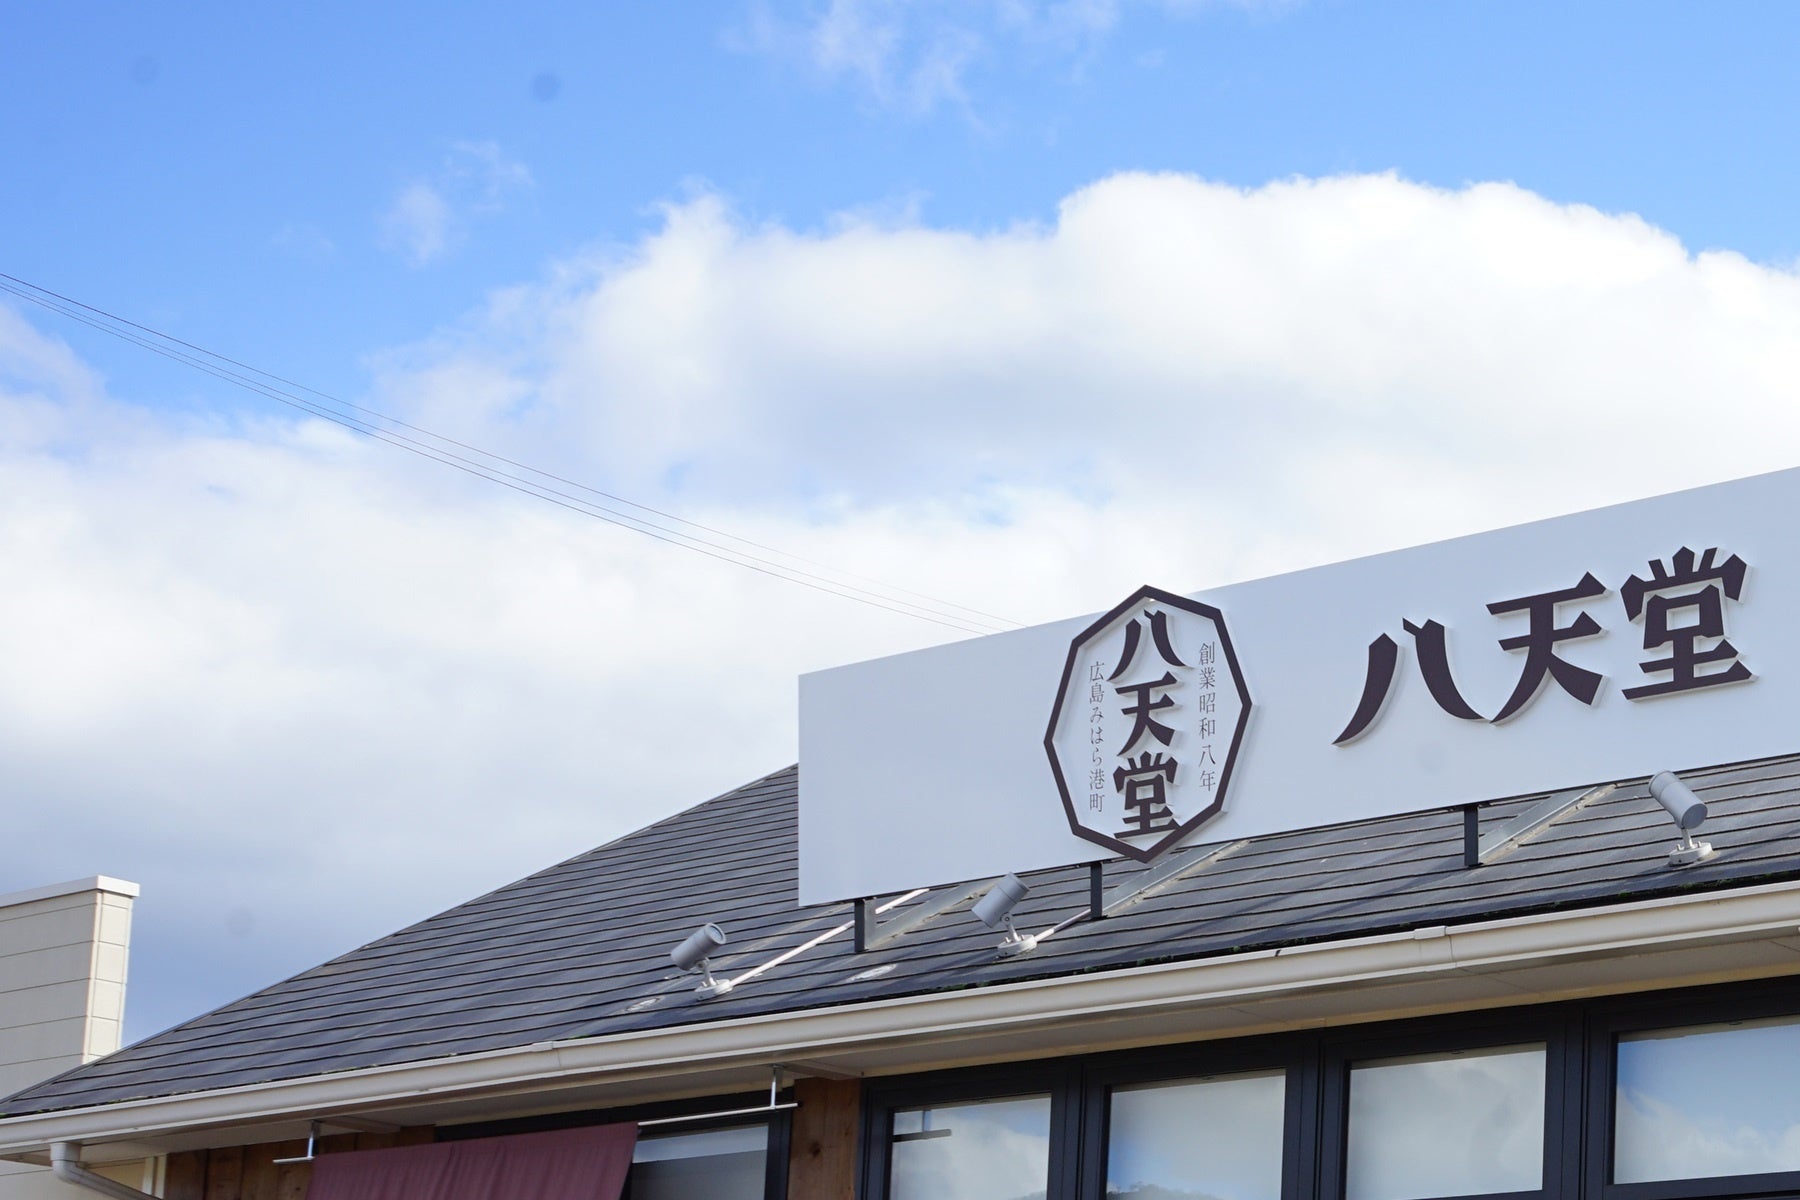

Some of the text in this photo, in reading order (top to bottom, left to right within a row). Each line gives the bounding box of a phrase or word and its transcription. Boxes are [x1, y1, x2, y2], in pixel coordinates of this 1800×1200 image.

[1107, 609, 1186, 839] 八天堂
[1199, 641, 1216, 792] 創業昭和八年
[1332, 546, 1753, 745] 八天堂
[1089, 661, 1105, 813] 広島みはら港町
